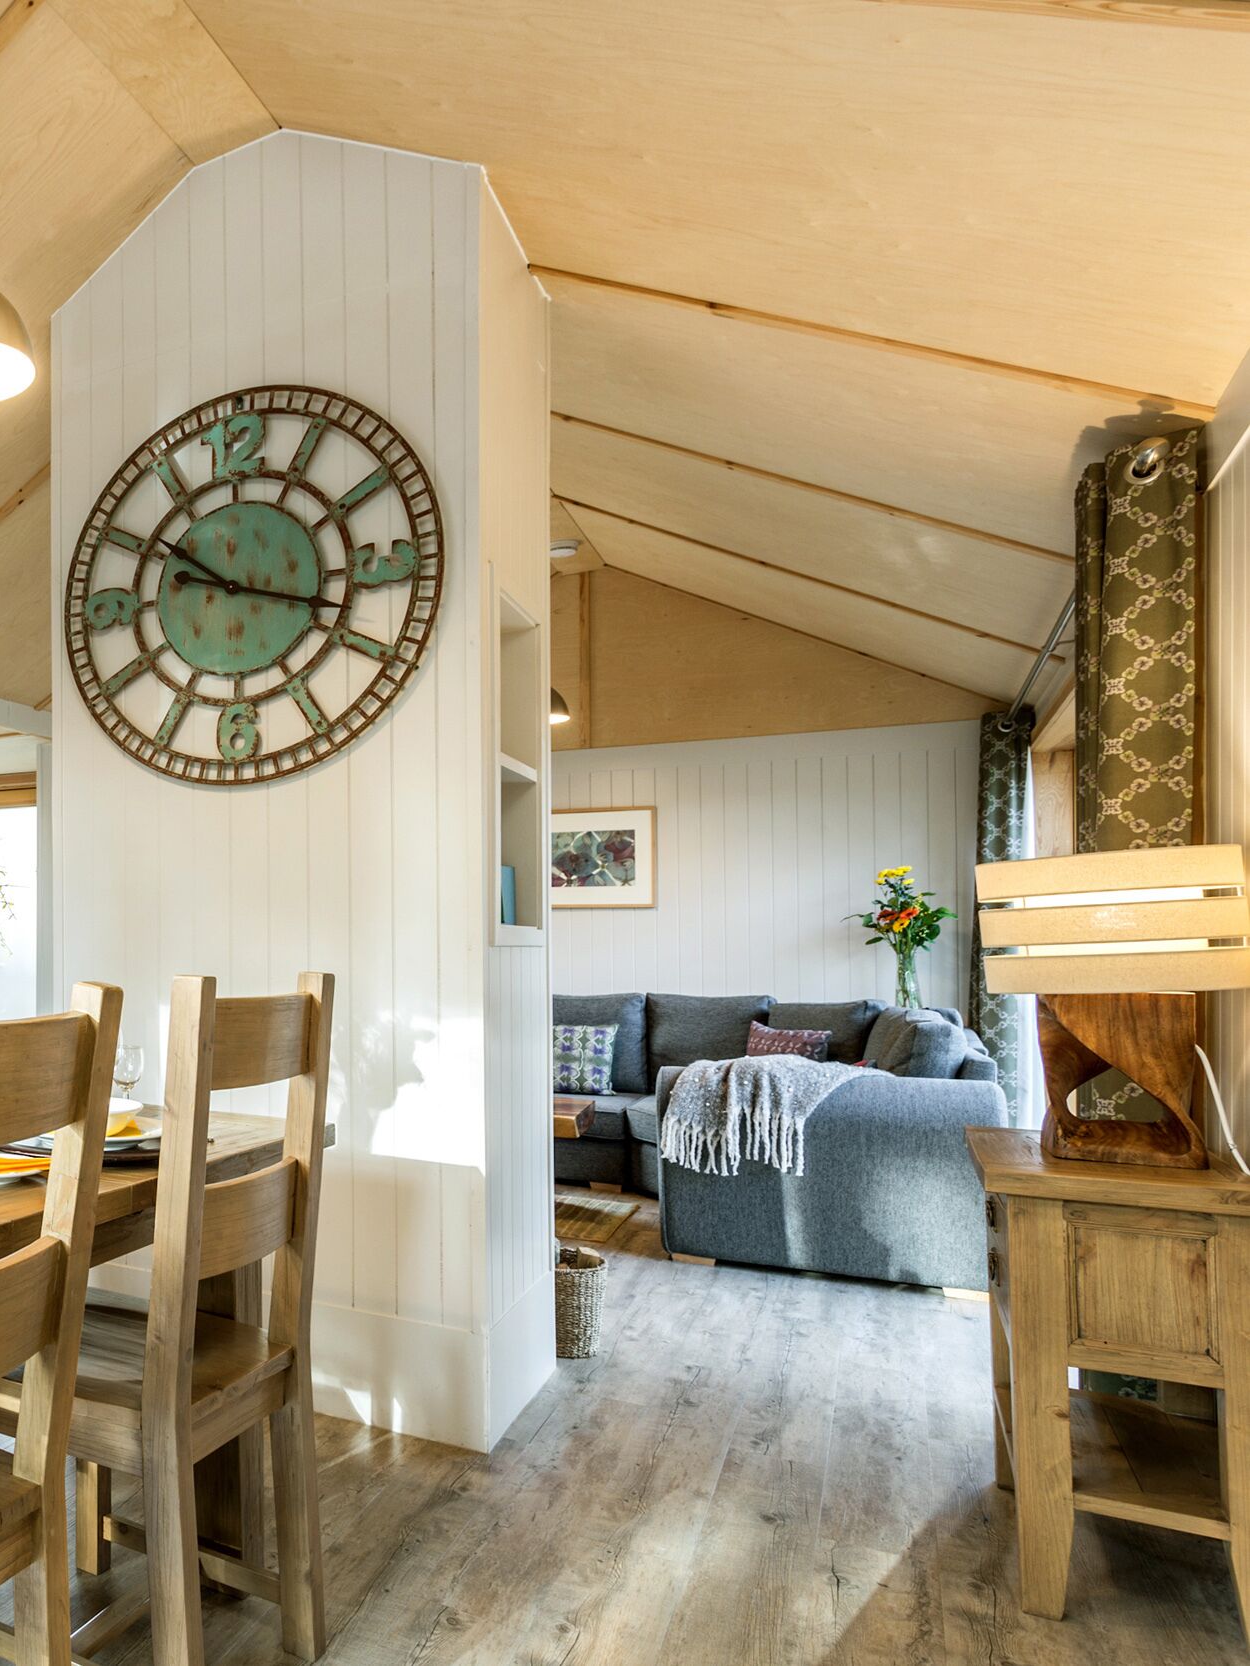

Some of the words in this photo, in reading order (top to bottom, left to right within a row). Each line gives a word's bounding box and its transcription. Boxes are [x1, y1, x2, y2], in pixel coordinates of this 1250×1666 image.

[201, 413, 266, 478] 12
[352, 538, 419, 590] 3
[85, 587, 139, 630] 9
[217, 703, 260, 761] 6
